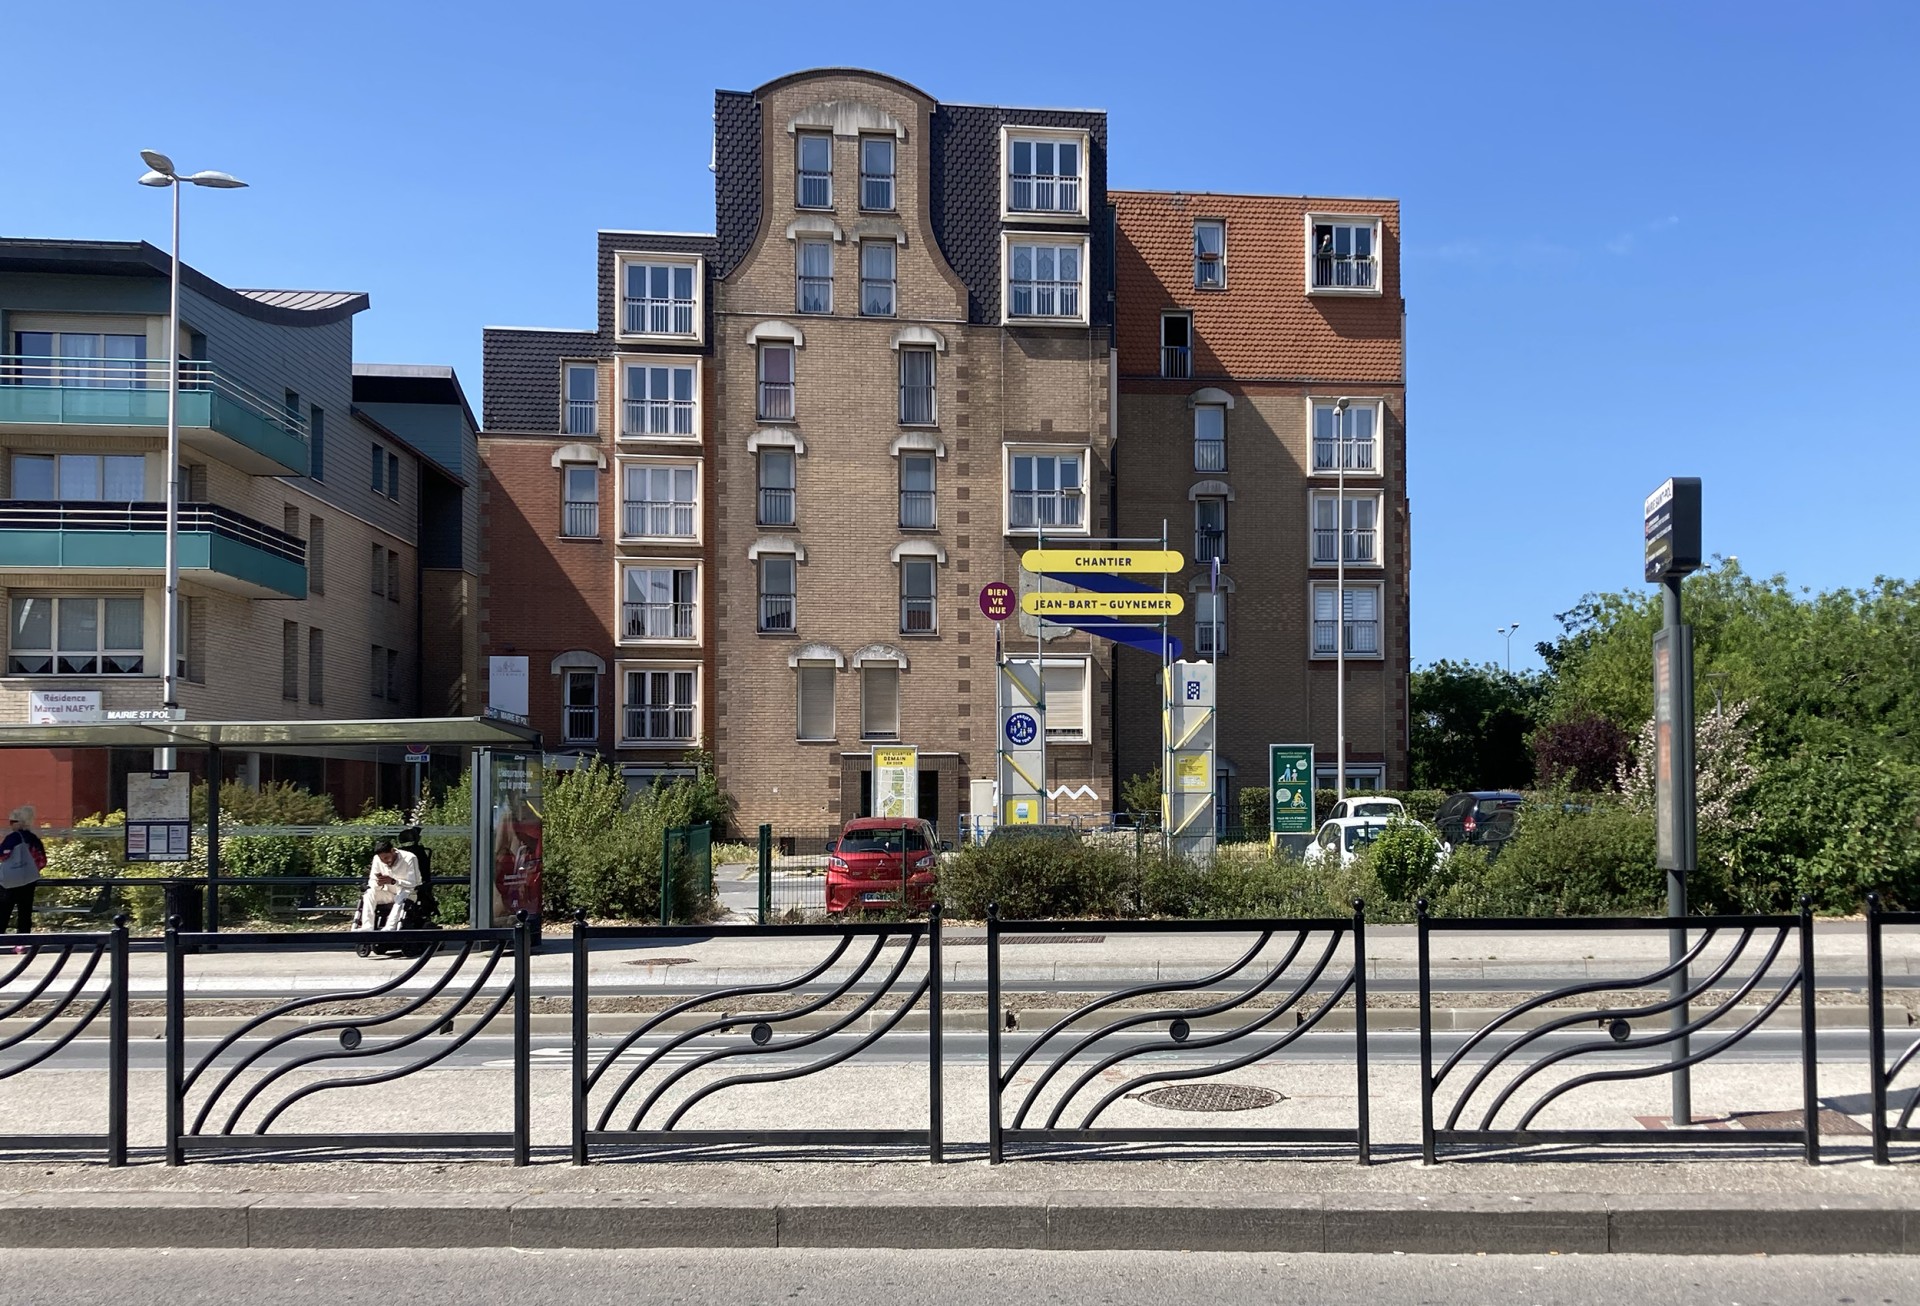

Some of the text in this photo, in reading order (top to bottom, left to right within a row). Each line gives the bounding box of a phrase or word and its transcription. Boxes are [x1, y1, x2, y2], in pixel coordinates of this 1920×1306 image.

[1075, 557, 1132, 566] CHANTIER
[987, 588, 1008, 596] BIEN
[991, 597, 1004, 605] VE
[1033, 600, 1098, 611] JEAN-BART
[1109, 600, 1172, 609] GUYNEMER
[988, 606, 1007, 614] NUE
[43, 693, 87, 702] Résidence
[34, 704, 63, 712] Marcel
[107, 710, 171, 719] MAIRIE ST POL
